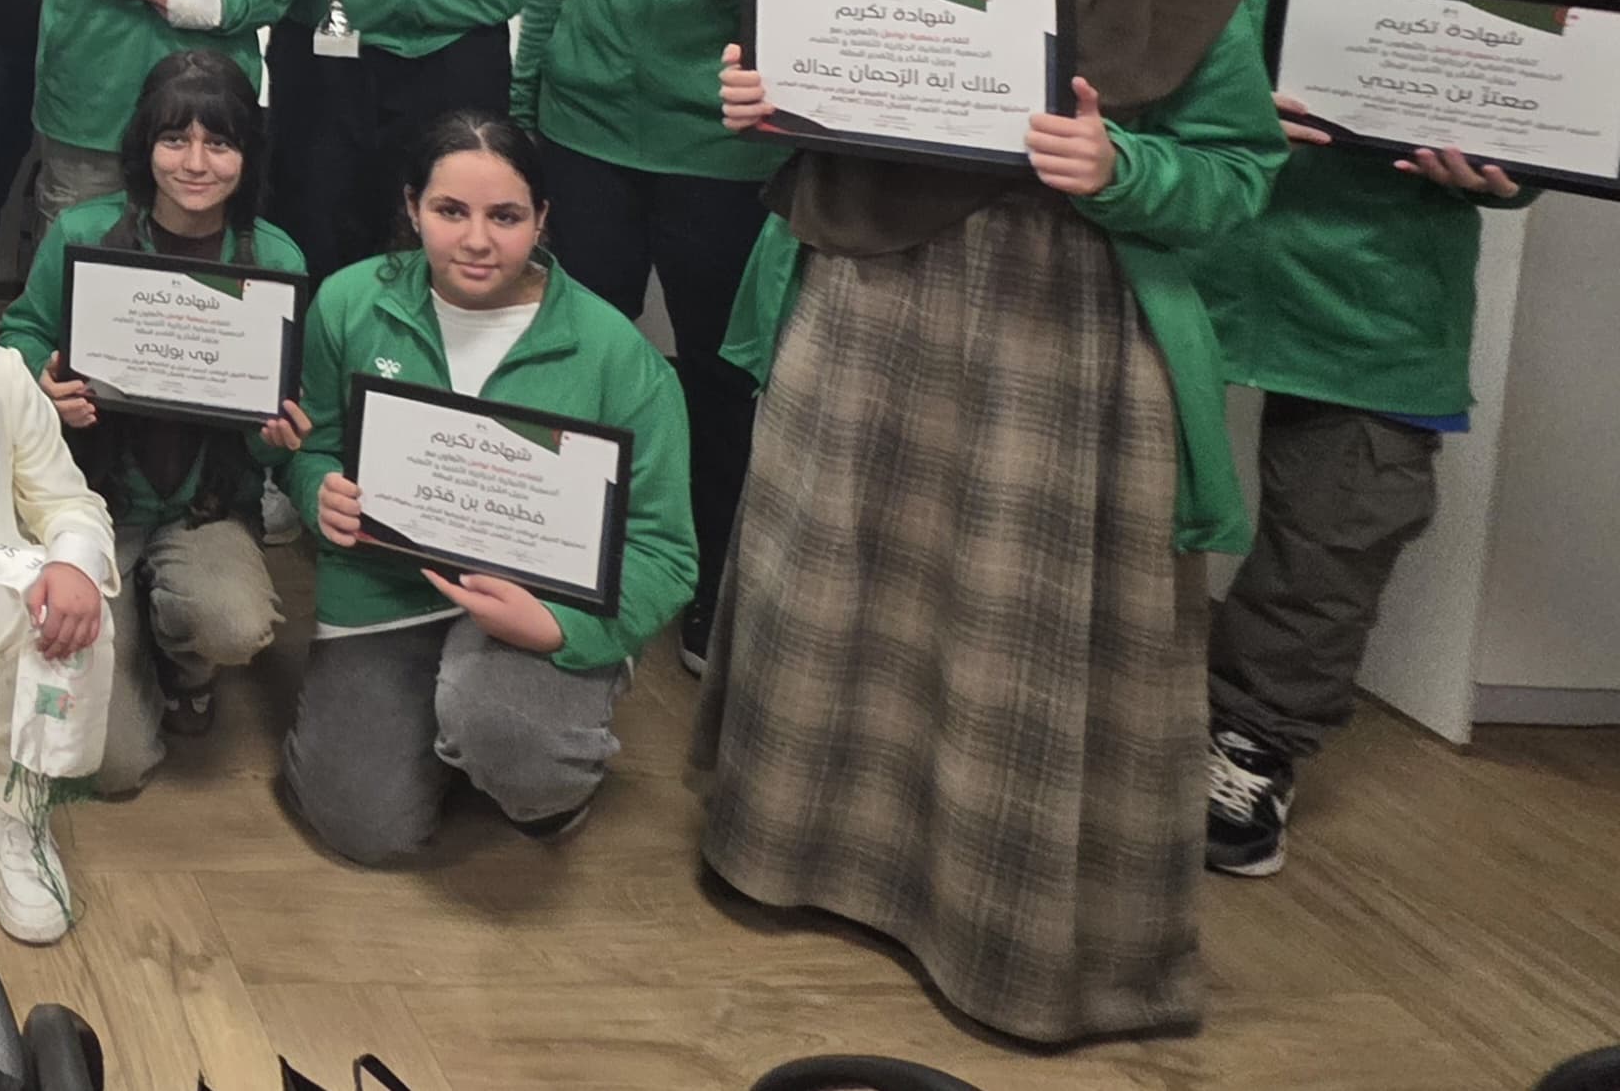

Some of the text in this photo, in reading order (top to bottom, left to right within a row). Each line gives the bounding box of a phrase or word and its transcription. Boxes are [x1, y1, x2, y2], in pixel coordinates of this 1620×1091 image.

[835, 4, 957, 28] شهادة تكريم
[1375, 15, 1525, 47] شهادة تكريم
[962, 73, 1011, 96] ملاك
[1445, 84, 1473, 103] بن
[132, 290, 220, 311] شهادة تكريم
[430, 429, 532, 462] شهادة تكريم
